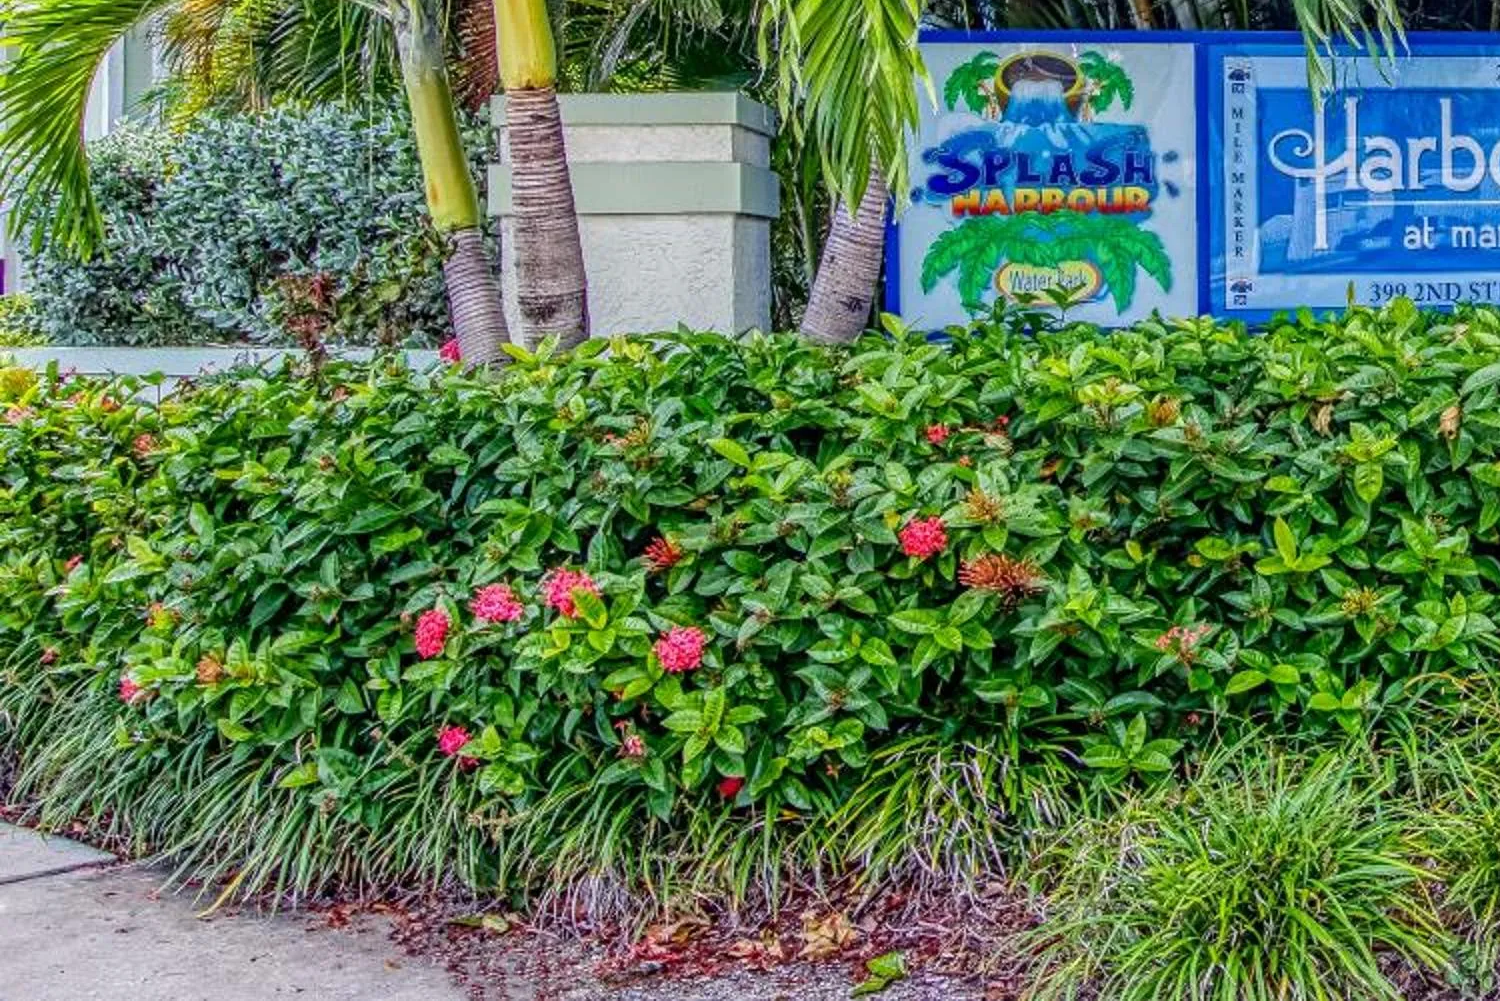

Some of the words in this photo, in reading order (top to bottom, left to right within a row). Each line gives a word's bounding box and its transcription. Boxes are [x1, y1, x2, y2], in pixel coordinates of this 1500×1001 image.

[1231, 106, 1246, 164] MILE
[923, 129, 1154, 195] SPLASH
[951, 185, 1151, 216] HARBOUR
[1231, 171, 1246, 259] MARKER
[1402, 216, 1434, 249] at
[1009, 269, 1053, 292] Water
[1057, 268, 1087, 289] Park
[1368, 281, 1407, 302] 399
[1413, 281, 1462, 302] 2ND
